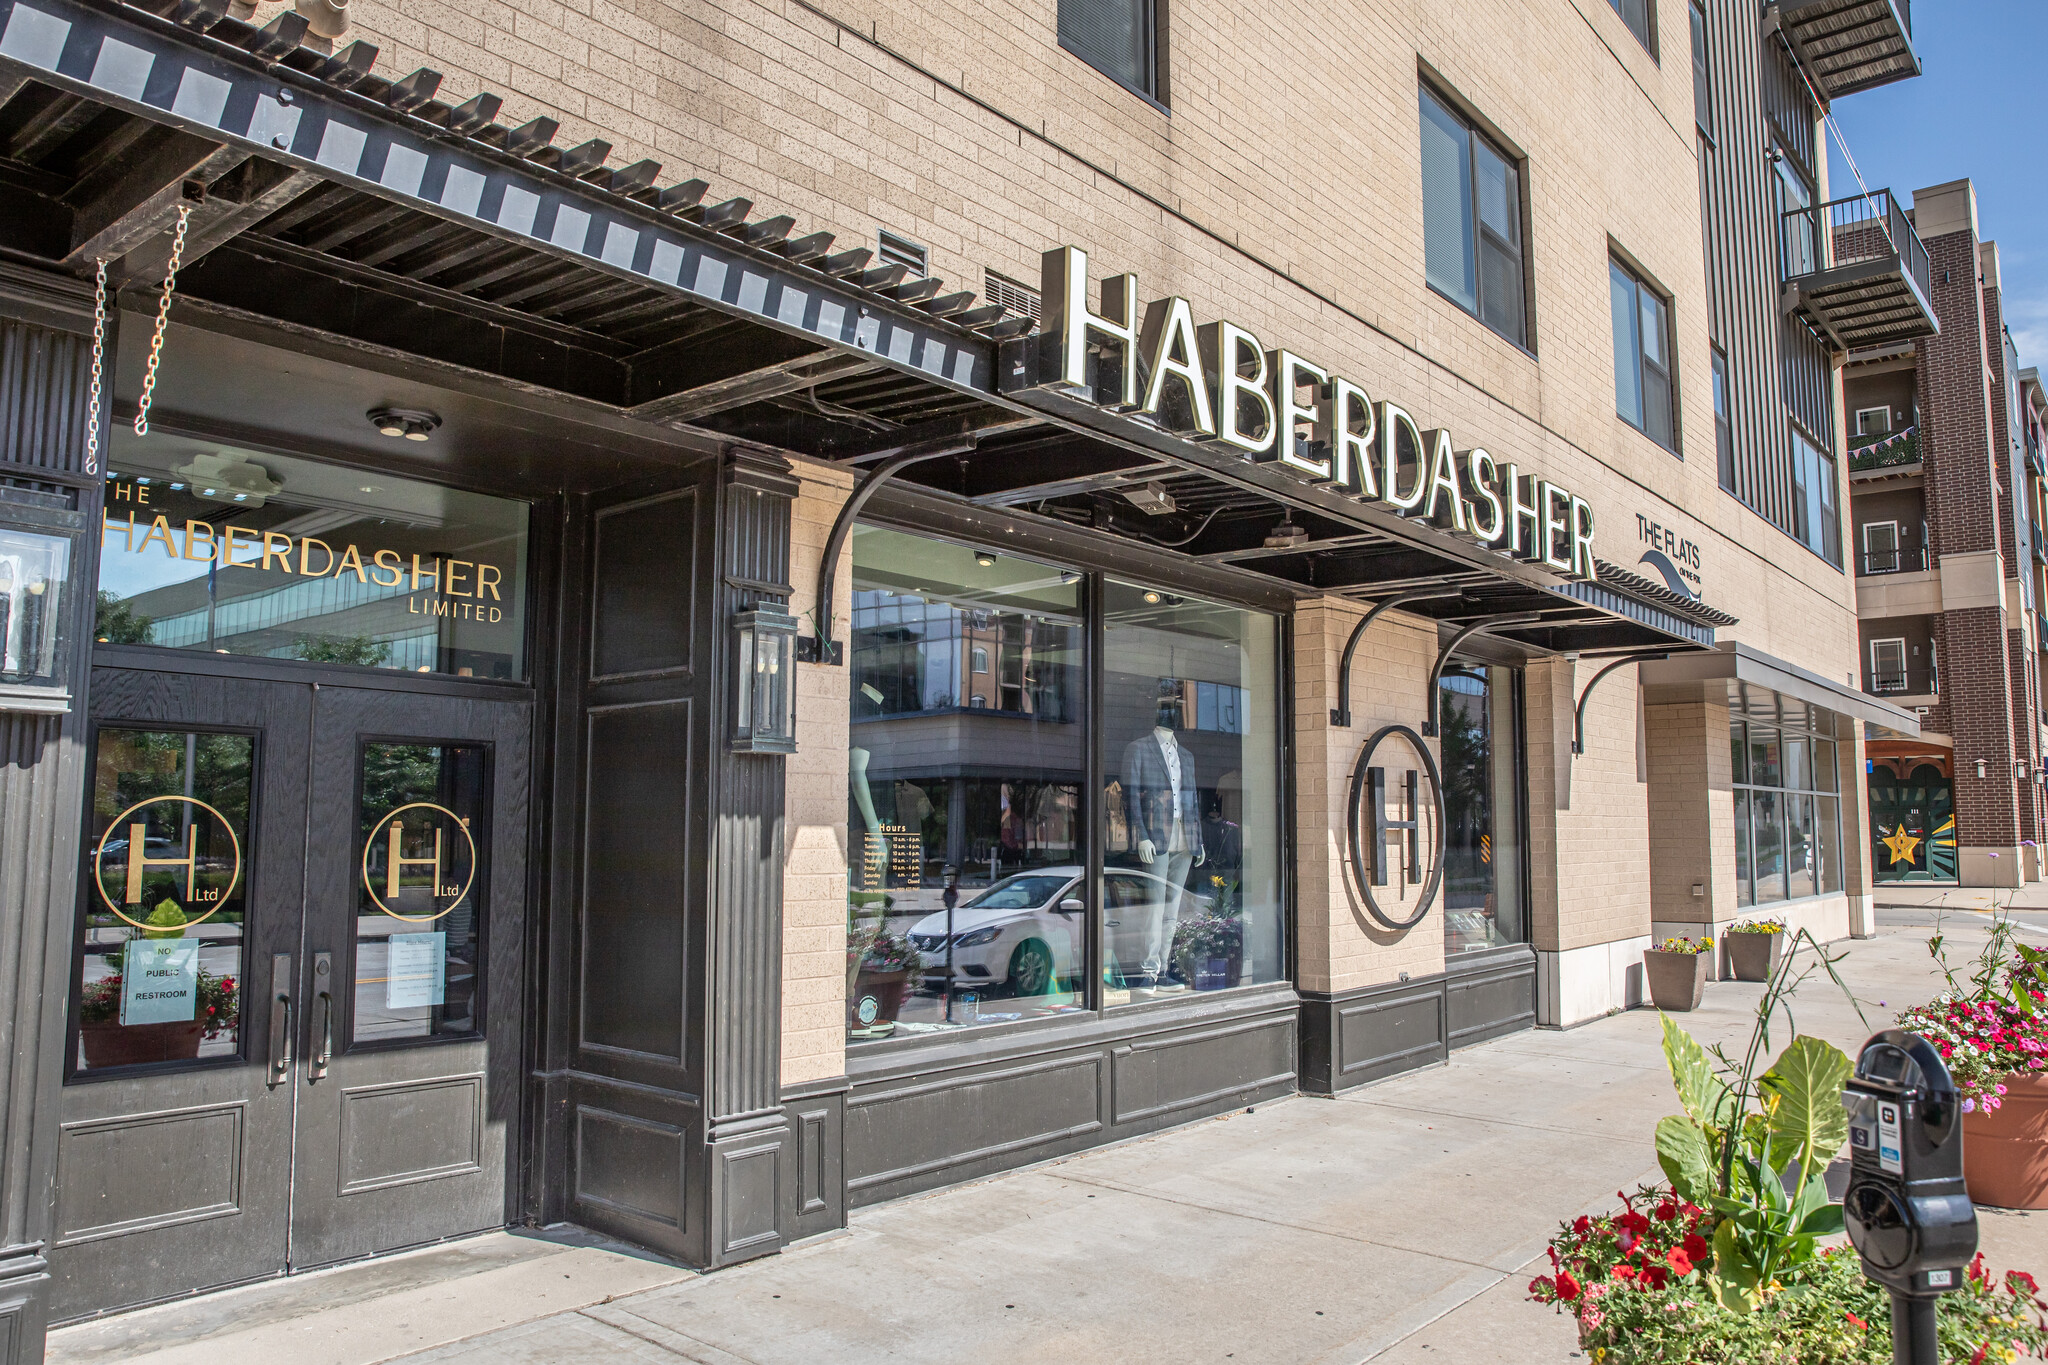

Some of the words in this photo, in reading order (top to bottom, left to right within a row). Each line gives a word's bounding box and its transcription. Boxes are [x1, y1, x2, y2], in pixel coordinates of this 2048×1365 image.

[1041, 245, 1598, 581] HABERDASHER
[101, 507, 501, 600] HABERDASHER
[1636, 513, 1662, 550] THE
[1665, 529, 1700, 569] FLATS
[410, 597, 501, 623] LIMITED
[879, 823, 906, 832] Hours
[1368, 767, 1421, 886] H
[126, 824, 197, 903] H
[195, 888, 219, 901] Ltd
[387, 828, 441, 898] H
[441, 884, 459, 897] Ltd
[146, 968, 180, 978] PUBLIC
[157, 947, 171, 956] NO
[135, 990, 187, 1001] RESTROOM
